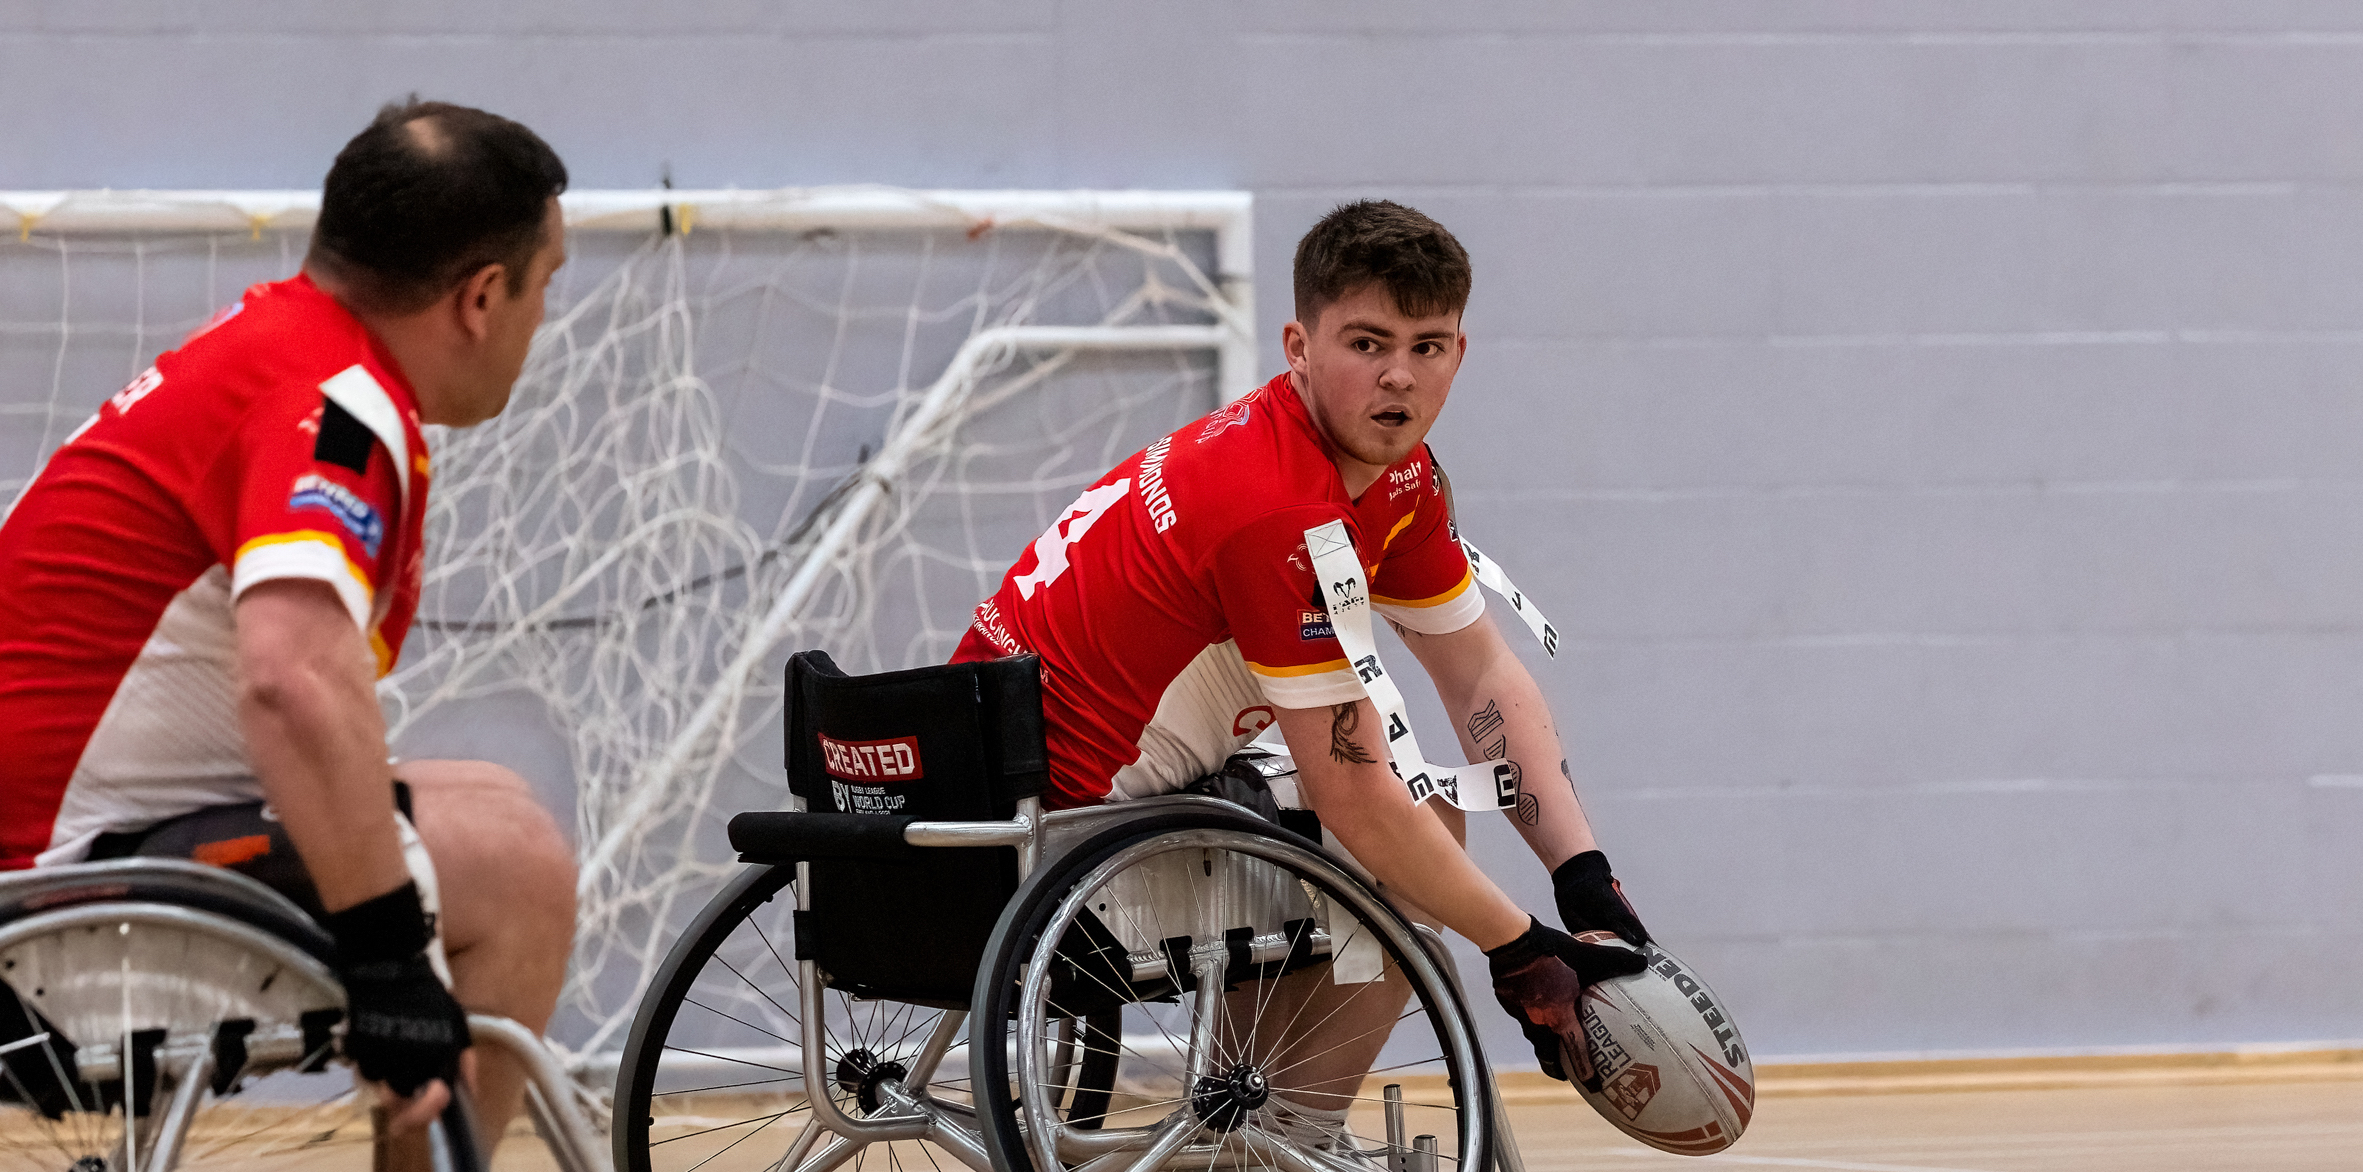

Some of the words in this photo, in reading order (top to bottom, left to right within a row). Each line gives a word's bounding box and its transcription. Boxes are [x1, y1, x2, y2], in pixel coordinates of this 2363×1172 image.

[823, 739, 915, 776] CREATED
[832, 780, 852, 813] BY
[852, 795, 883, 809] WORLD
[884, 795, 905, 809] CUP
[1584, 1004, 1631, 1068] LEAGUE
